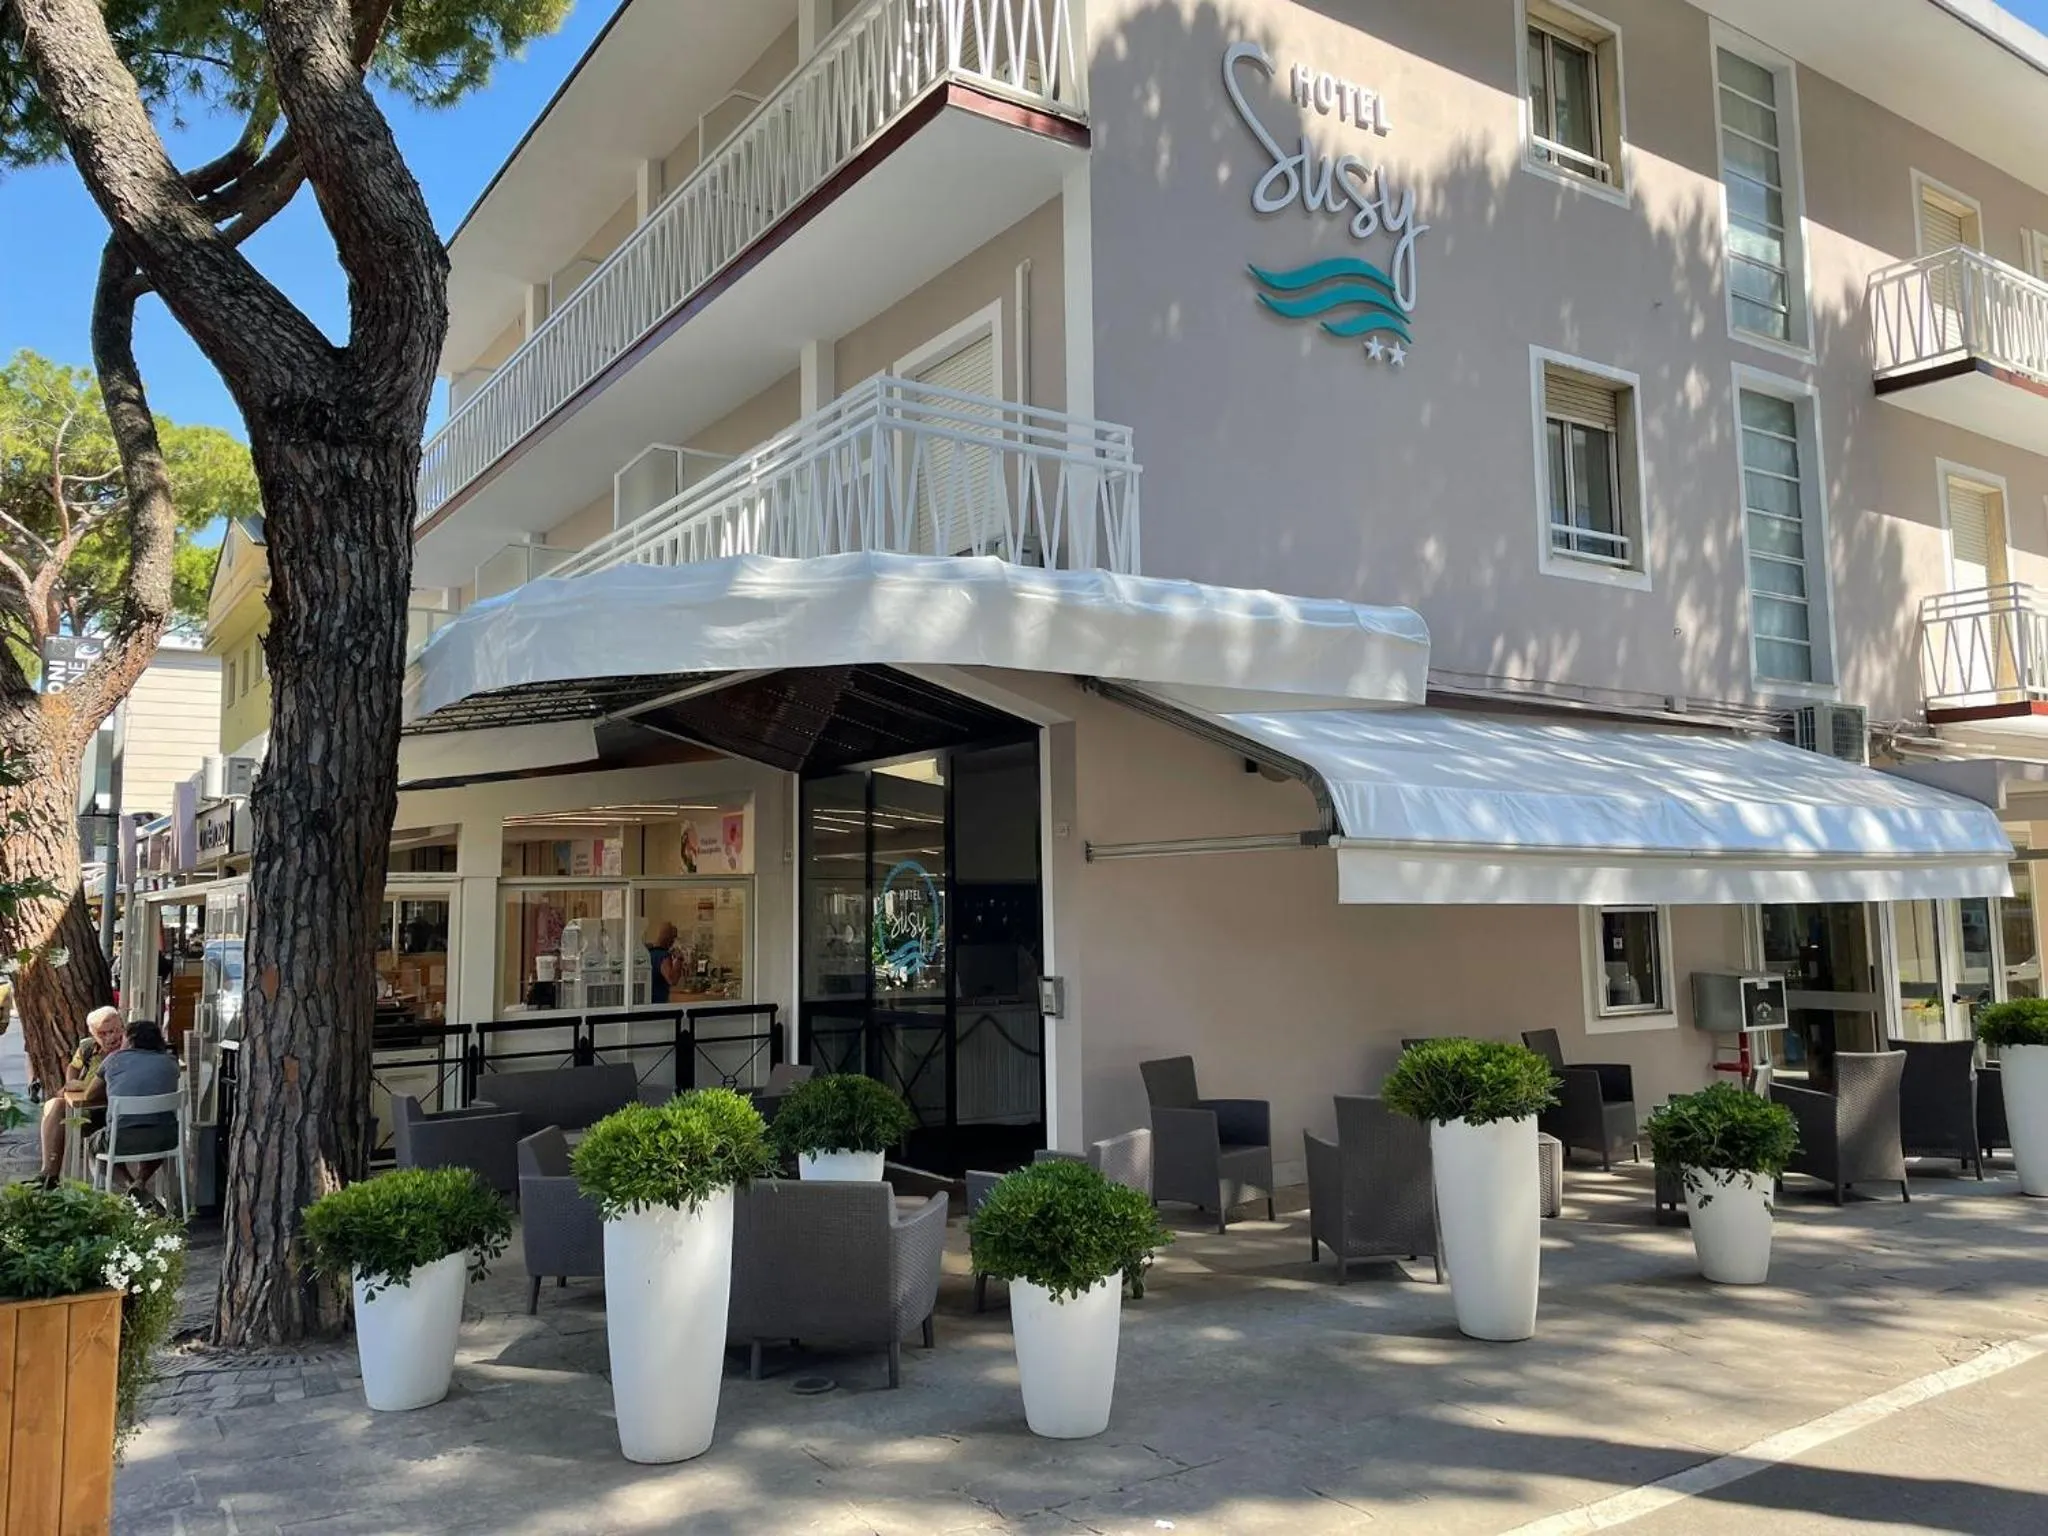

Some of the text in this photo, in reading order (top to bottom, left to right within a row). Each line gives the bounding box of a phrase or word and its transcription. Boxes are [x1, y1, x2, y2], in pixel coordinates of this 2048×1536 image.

[1290, 62, 1393, 135] HOTEL
[1222, 41, 1431, 313] Susy
[899, 889, 922, 901] HOTEL
